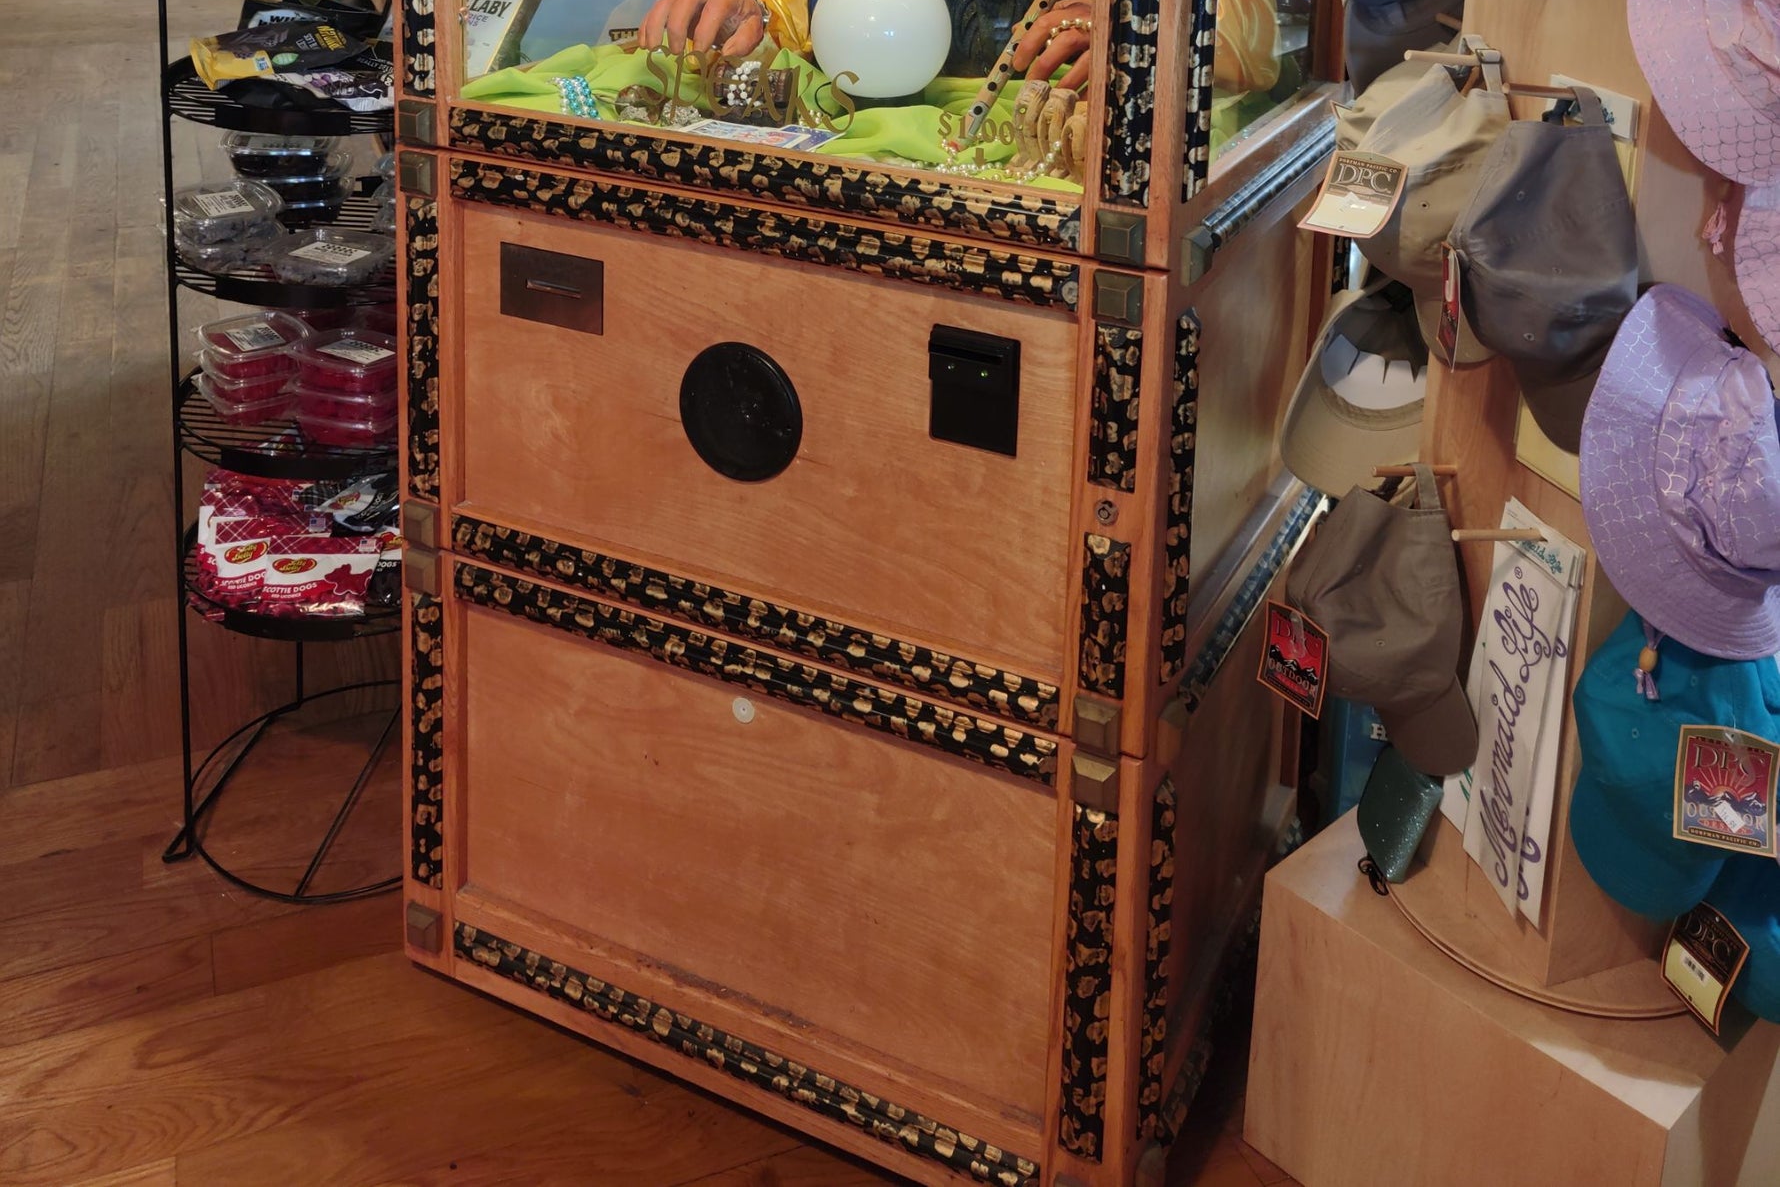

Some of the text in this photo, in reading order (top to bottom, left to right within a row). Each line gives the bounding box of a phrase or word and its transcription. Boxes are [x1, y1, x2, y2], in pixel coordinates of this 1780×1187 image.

[646, 44, 860, 134] SPEAKS
[937, 111, 1015, 146] $1.00
[1335, 163, 1392, 194] DPC
[293, 582, 317, 592] DOGS
[1268, 658, 1317, 698] OUTDOOR
[1480, 659, 1526, 889] Mermaid
[1686, 801, 1765, 832] OUTOR
